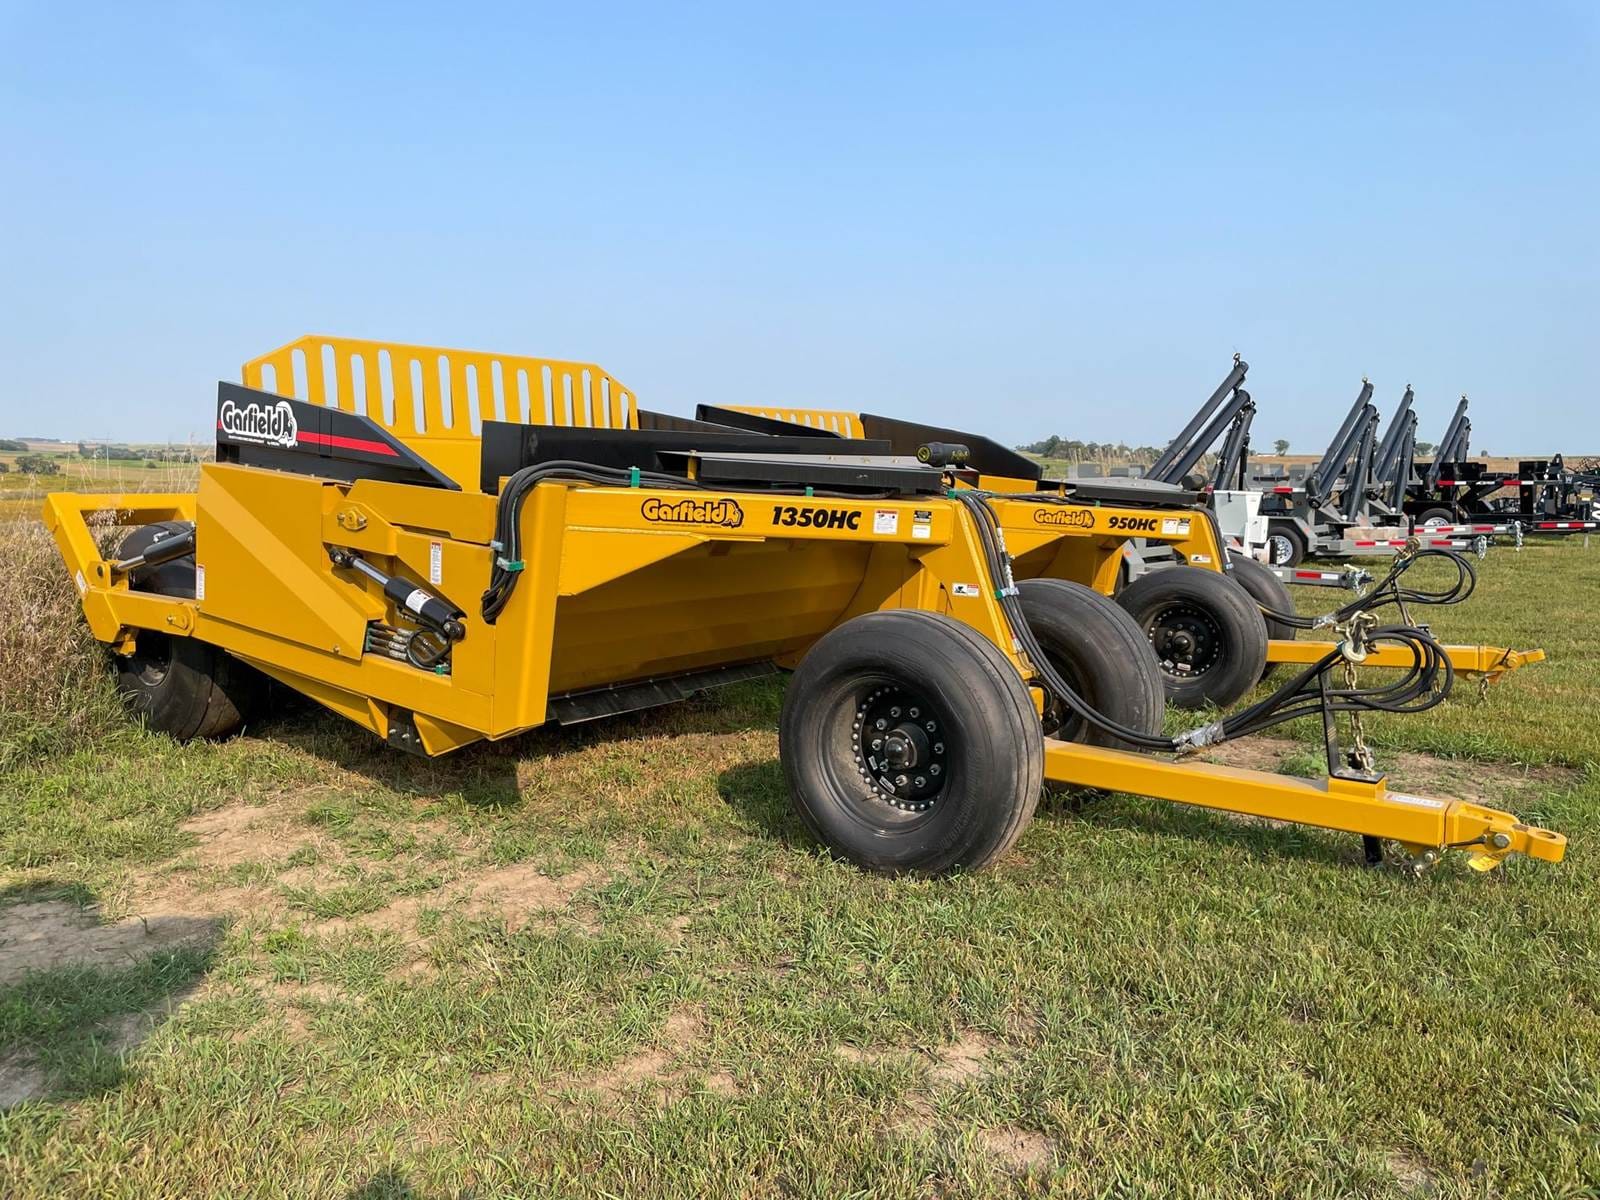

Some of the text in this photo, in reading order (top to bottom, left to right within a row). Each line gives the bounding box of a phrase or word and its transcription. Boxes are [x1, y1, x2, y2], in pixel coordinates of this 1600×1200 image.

[221, 401, 282, 439] Garfield
[641, 498, 726, 524] Garfield
[772, 506, 862, 530] 1350HC
[1034, 509, 1084, 527] Garfield
[1108, 516, 1158, 531] 950HC
